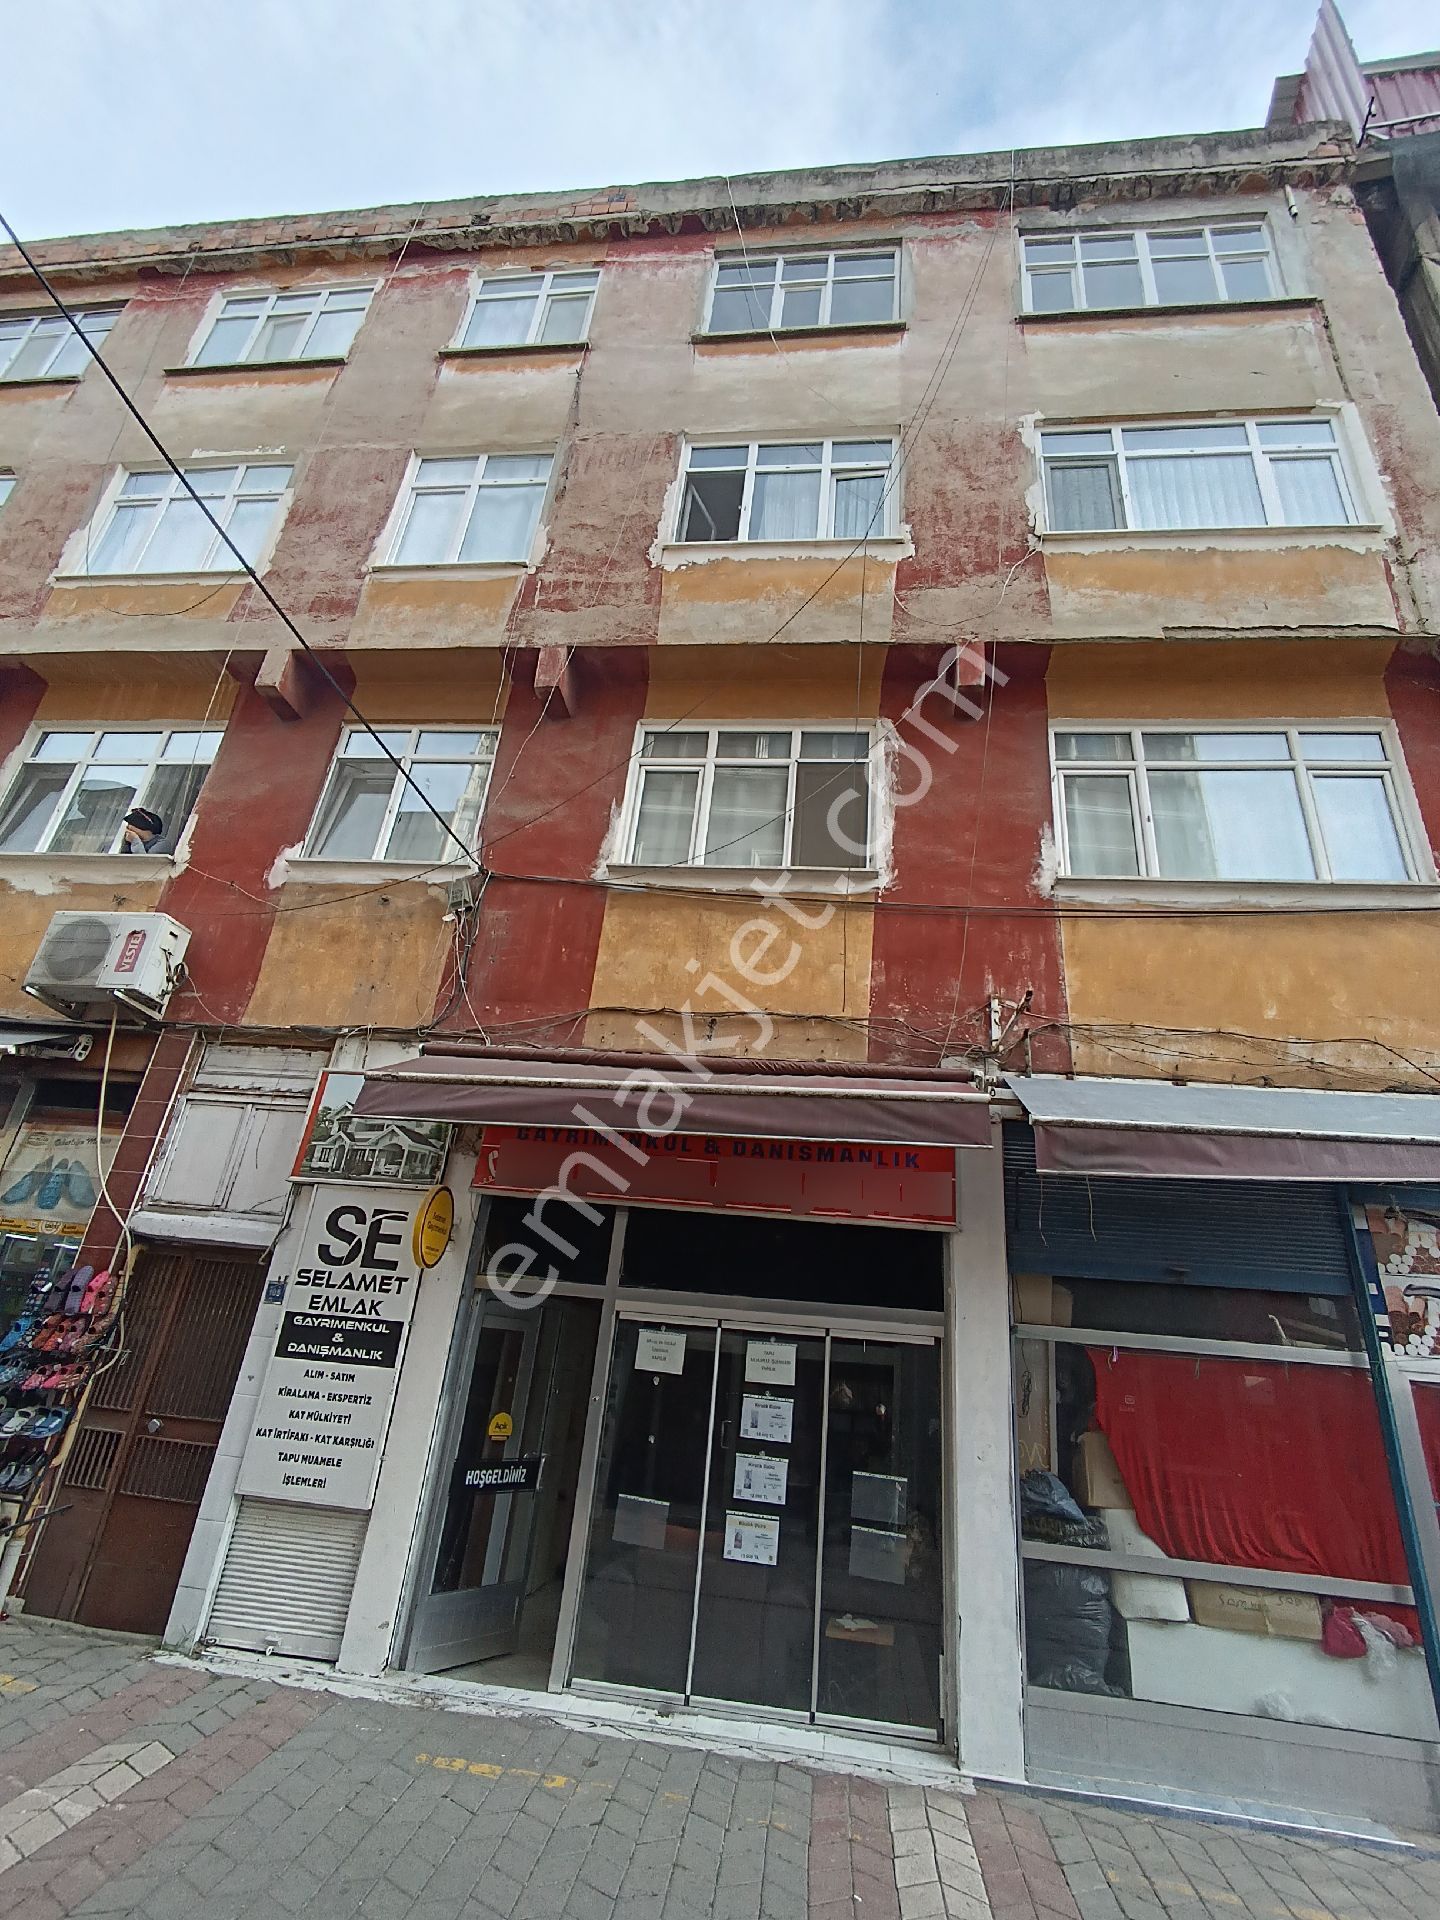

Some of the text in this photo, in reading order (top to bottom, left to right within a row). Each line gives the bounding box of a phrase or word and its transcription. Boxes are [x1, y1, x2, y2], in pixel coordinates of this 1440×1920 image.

[119, 930, 145, 971] VESTEL
[703, 1138, 720, 1156] &
[318, 1205, 409, 1271] SE
[295, 1268, 410, 1295] SELAMET
[308, 1294, 385, 1317] EMLAK
[293, 1315, 391, 1334] GAYRIMENKUL
[331, 1333, 345, 1343] &
[287, 1342, 384, 1360] DANIŞMANLIK
[303, 1369, 325, 1380] ALIM
[330, 1371, 356, 1383] SATIM
[277, 1385, 320, 1400] KİRALAMA
[326, 1392, 373, 1406] EKSPERTİZ
[288, 1409, 352, 1425] KAT MÜLKİYETİ
[255, 1427, 273, 1438] KAT
[273, 1427, 310, 1442] İRTİFAKI
[314, 1433, 333, 1446] KAT
[332, 1435, 375, 1449] KARŞILIĞI
[278, 1451, 343, 1468] TAPU MUAMELE
[282, 1472, 327, 1489] İŞLEMLERİ
[465, 1465, 527, 1488] HOŞGELDİNİZ
